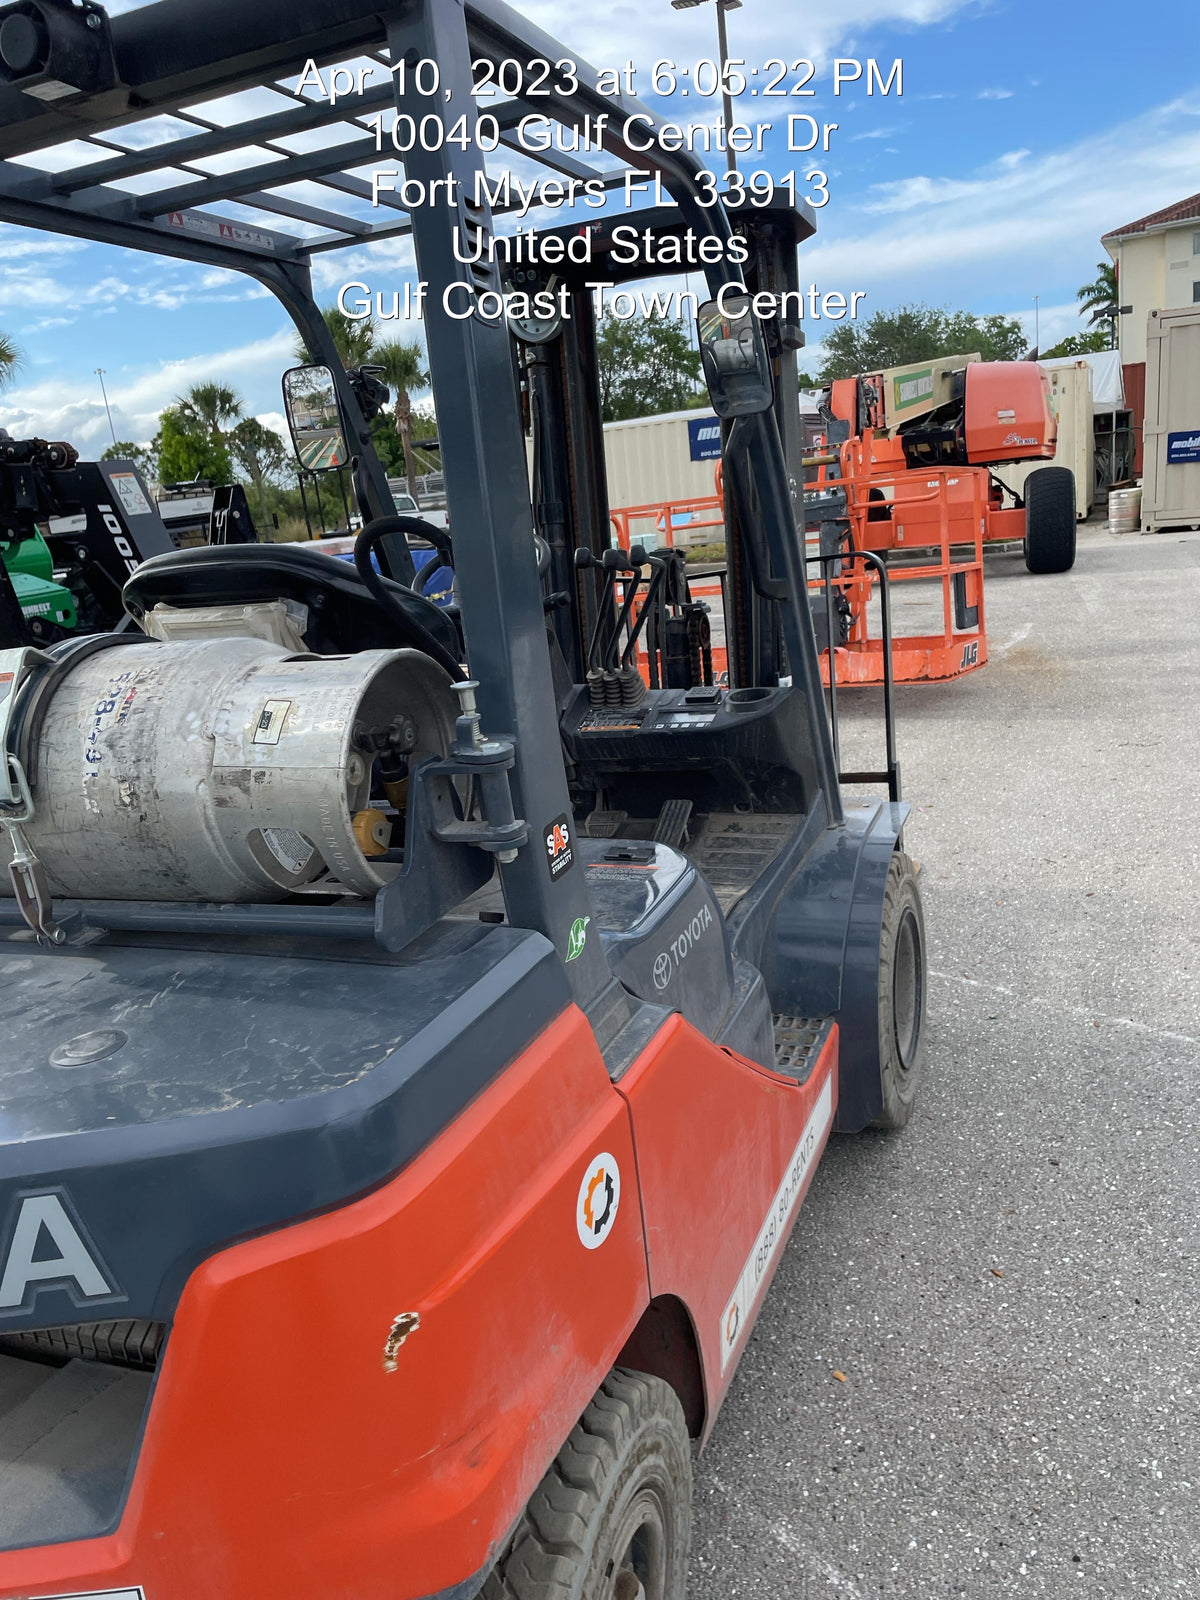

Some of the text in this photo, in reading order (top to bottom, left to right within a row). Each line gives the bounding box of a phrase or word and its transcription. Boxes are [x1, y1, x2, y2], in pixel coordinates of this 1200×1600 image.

[960, 640, 979, 670] JLG
[319, 798, 351, 872] MADE IN USA
[546, 823, 570, 858] SAS
[551, 852, 572, 875] STABILITY
[670, 903, 713, 966] TOYOTA
[754, 1126, 814, 1283] (888) 80-RENTS
